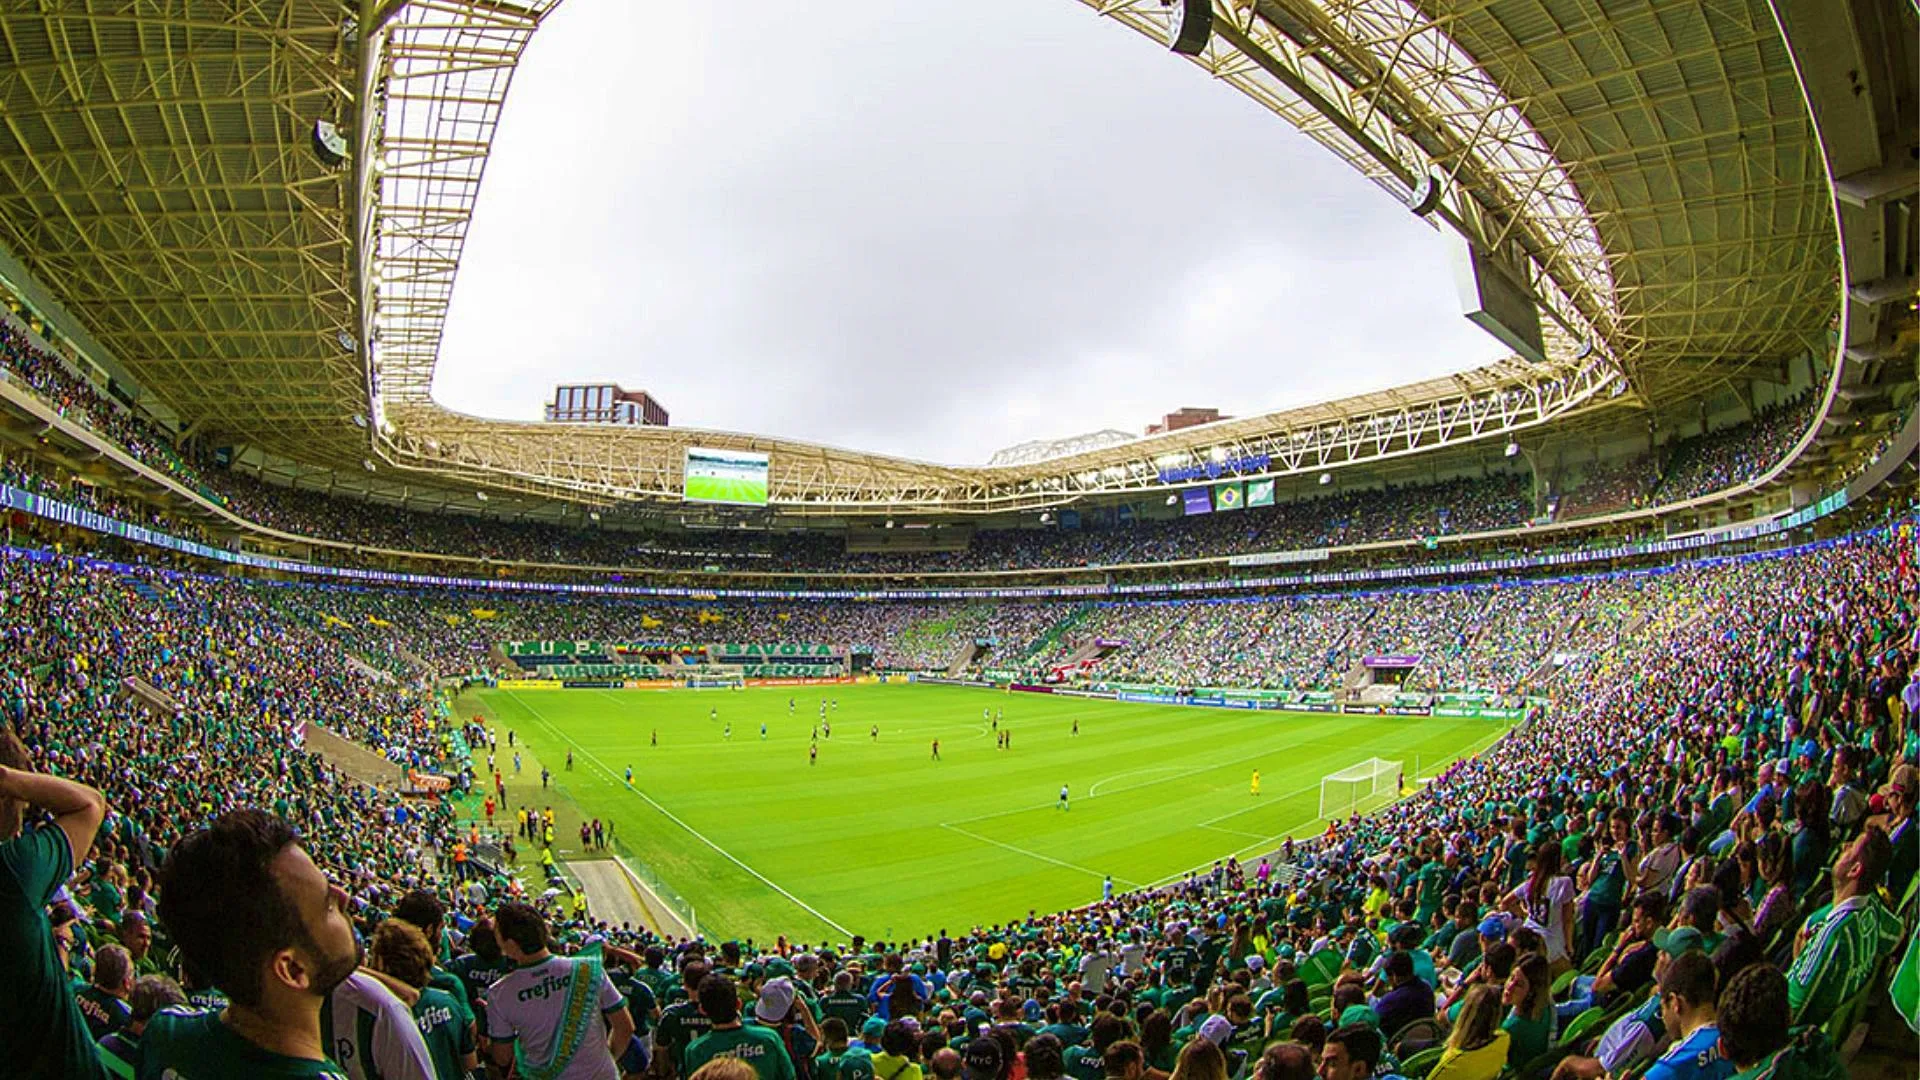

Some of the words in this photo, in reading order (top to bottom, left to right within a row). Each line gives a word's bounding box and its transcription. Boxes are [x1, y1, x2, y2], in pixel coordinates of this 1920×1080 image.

[37, 496, 77, 525] DIGITAL
[1648, 539, 1682, 552] DIGITAL
[1549, 551, 1590, 564] DIGITAL
[1592, 547, 1629, 560] ARENAS
[1381, 567, 1412, 578] DIGITAL
[1451, 561, 1488, 573] DIGITAL
[1314, 573, 1343, 582] DIGITAL
[743, 664, 827, 677] VERDE
[468, 969, 501, 984] crefi
[518, 975, 571, 1002] crefisa
[418, 1004, 452, 1034] efisa
[680, 1017, 712, 1026] SAMSU
